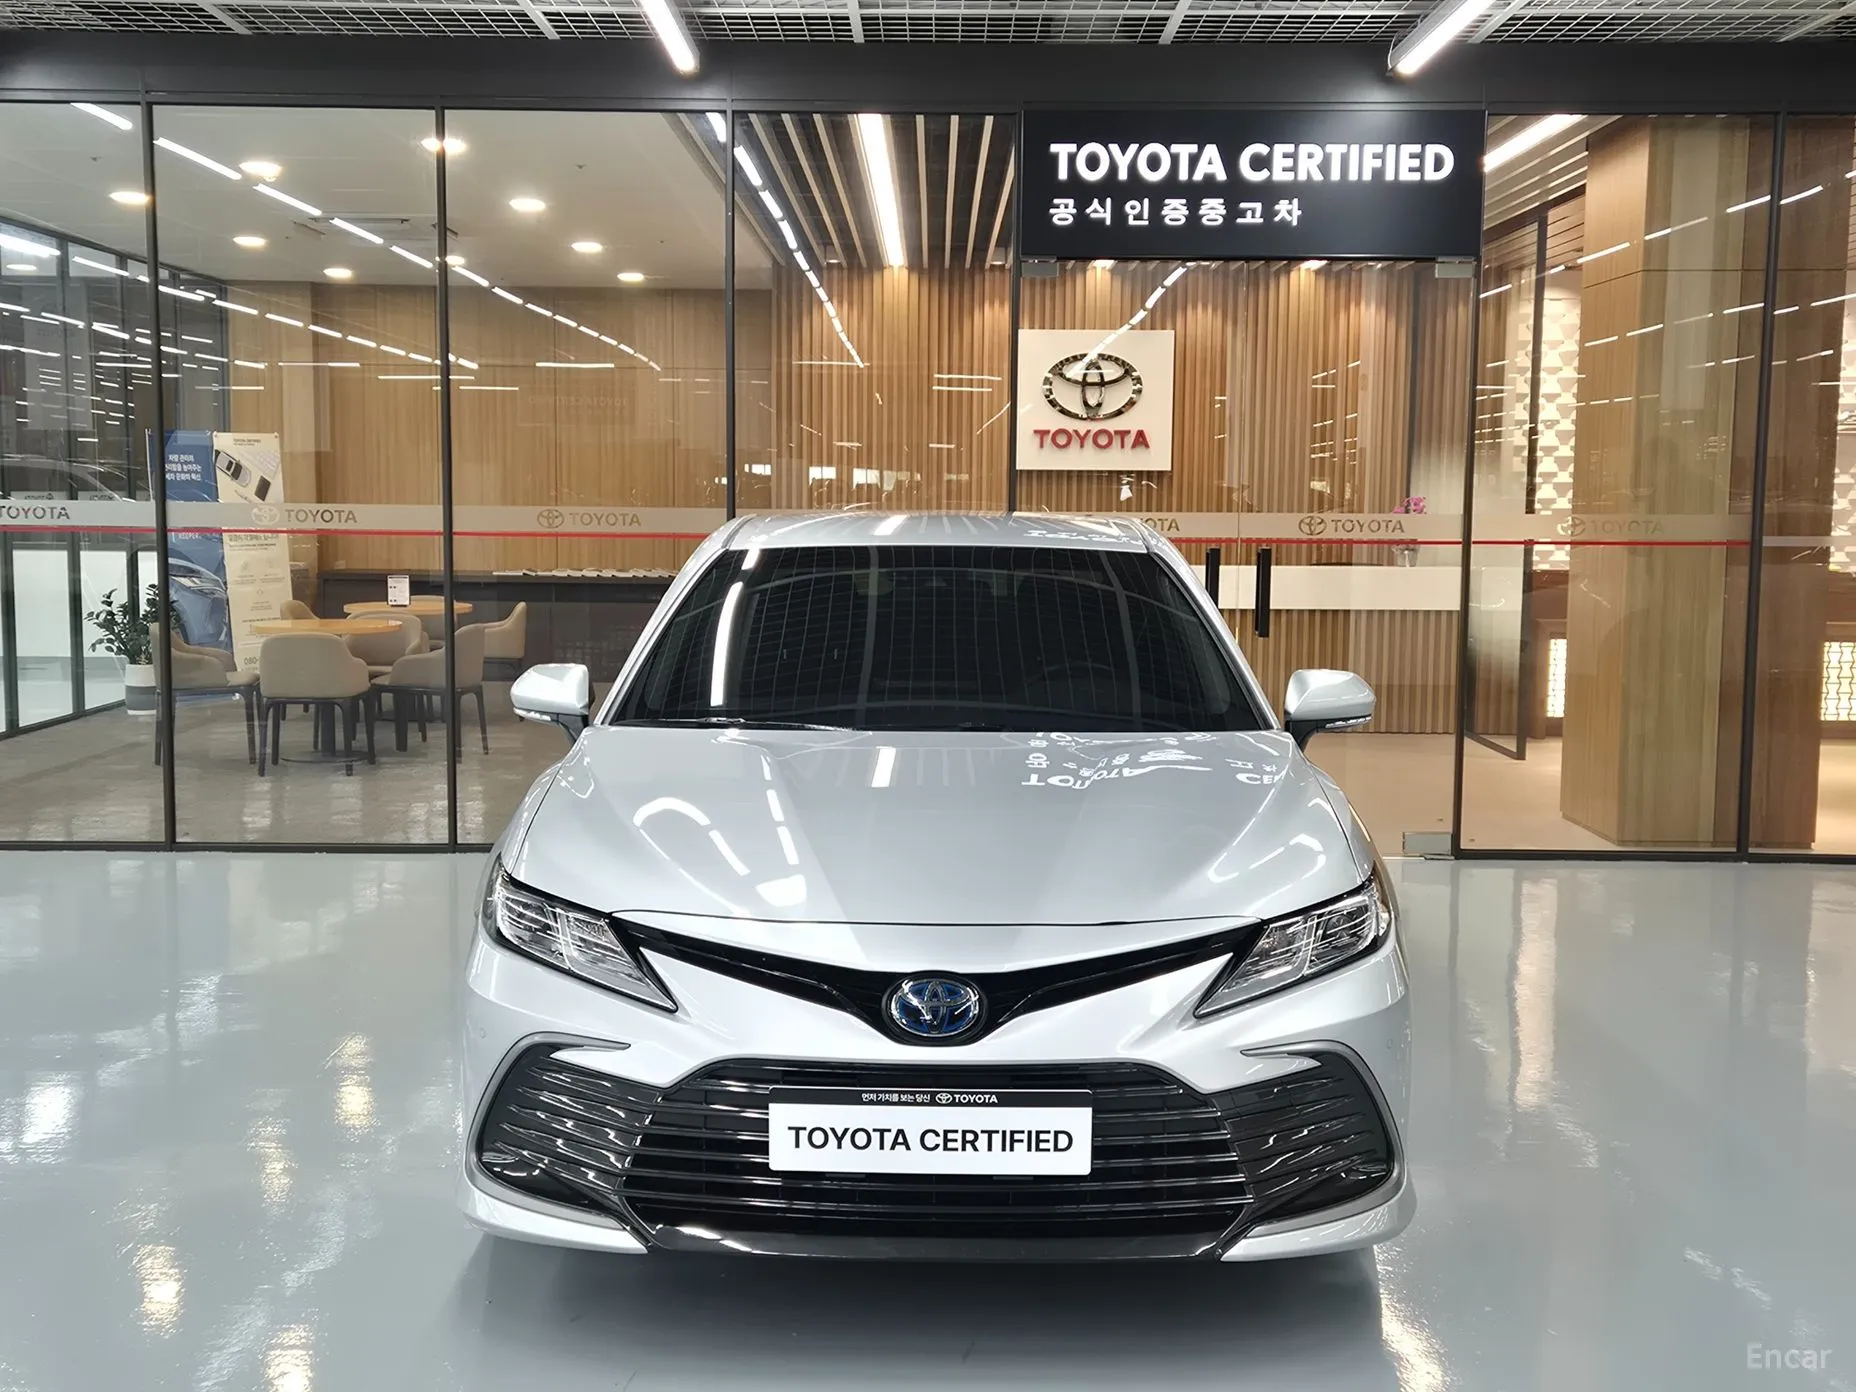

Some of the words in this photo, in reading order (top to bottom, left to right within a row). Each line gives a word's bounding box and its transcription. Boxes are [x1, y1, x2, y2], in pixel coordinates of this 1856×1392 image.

[1049, 142, 1228, 182] TOYOTA
[1238, 142, 1455, 182] CERTIFIED
[1049, 197, 1302, 226] 공식인증중고차
[1033, 428, 1150, 450] TOYOTA
[285, 509, 358, 524] TOYOTA
[569, 512, 642, 527] TOYOTA
[1331, 519, 1405, 533] TOYOTA
[1589, 520, 1664, 535] TOYOTA
[861, 1092, 877, 1102] 먼저
[877, 1092, 899, 1102] 가치를
[900, 1093, 915, 1103] 보는
[915, 1093, 930, 1103] 당신
[953, 1093, 998, 1104] TOYOTA
[787, 1126, 912, 1151] TOYOTA
[919, 1128, 1074, 1153] CERTIFIED
